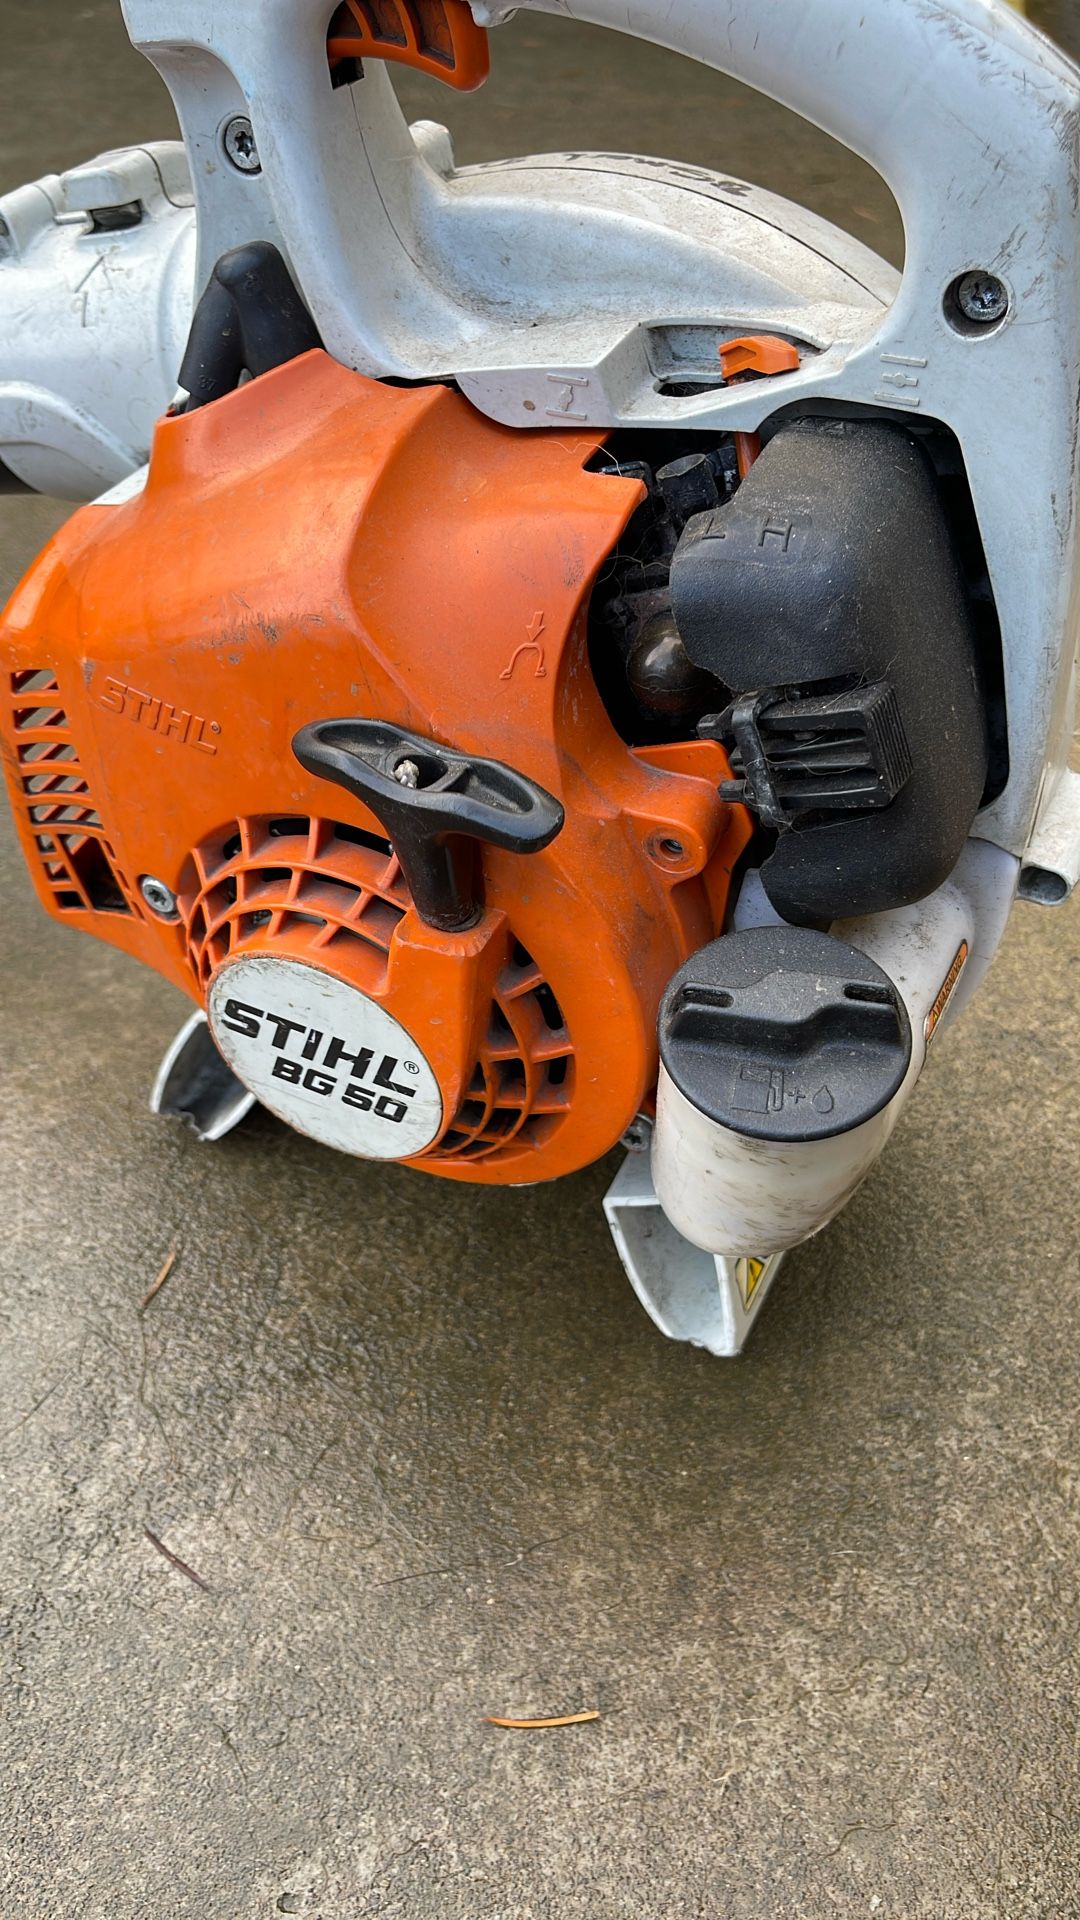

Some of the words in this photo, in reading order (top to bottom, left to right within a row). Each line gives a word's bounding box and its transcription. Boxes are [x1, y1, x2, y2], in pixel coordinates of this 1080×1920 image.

[702, 517, 726, 540] L
[758, 517, 792, 552] H
[101, 676, 217, 755] STIHL
[222, 999, 416, 1097] STIHL
[272, 1056, 337, 1095] BG
[341, 1083, 408, 1123] 50
